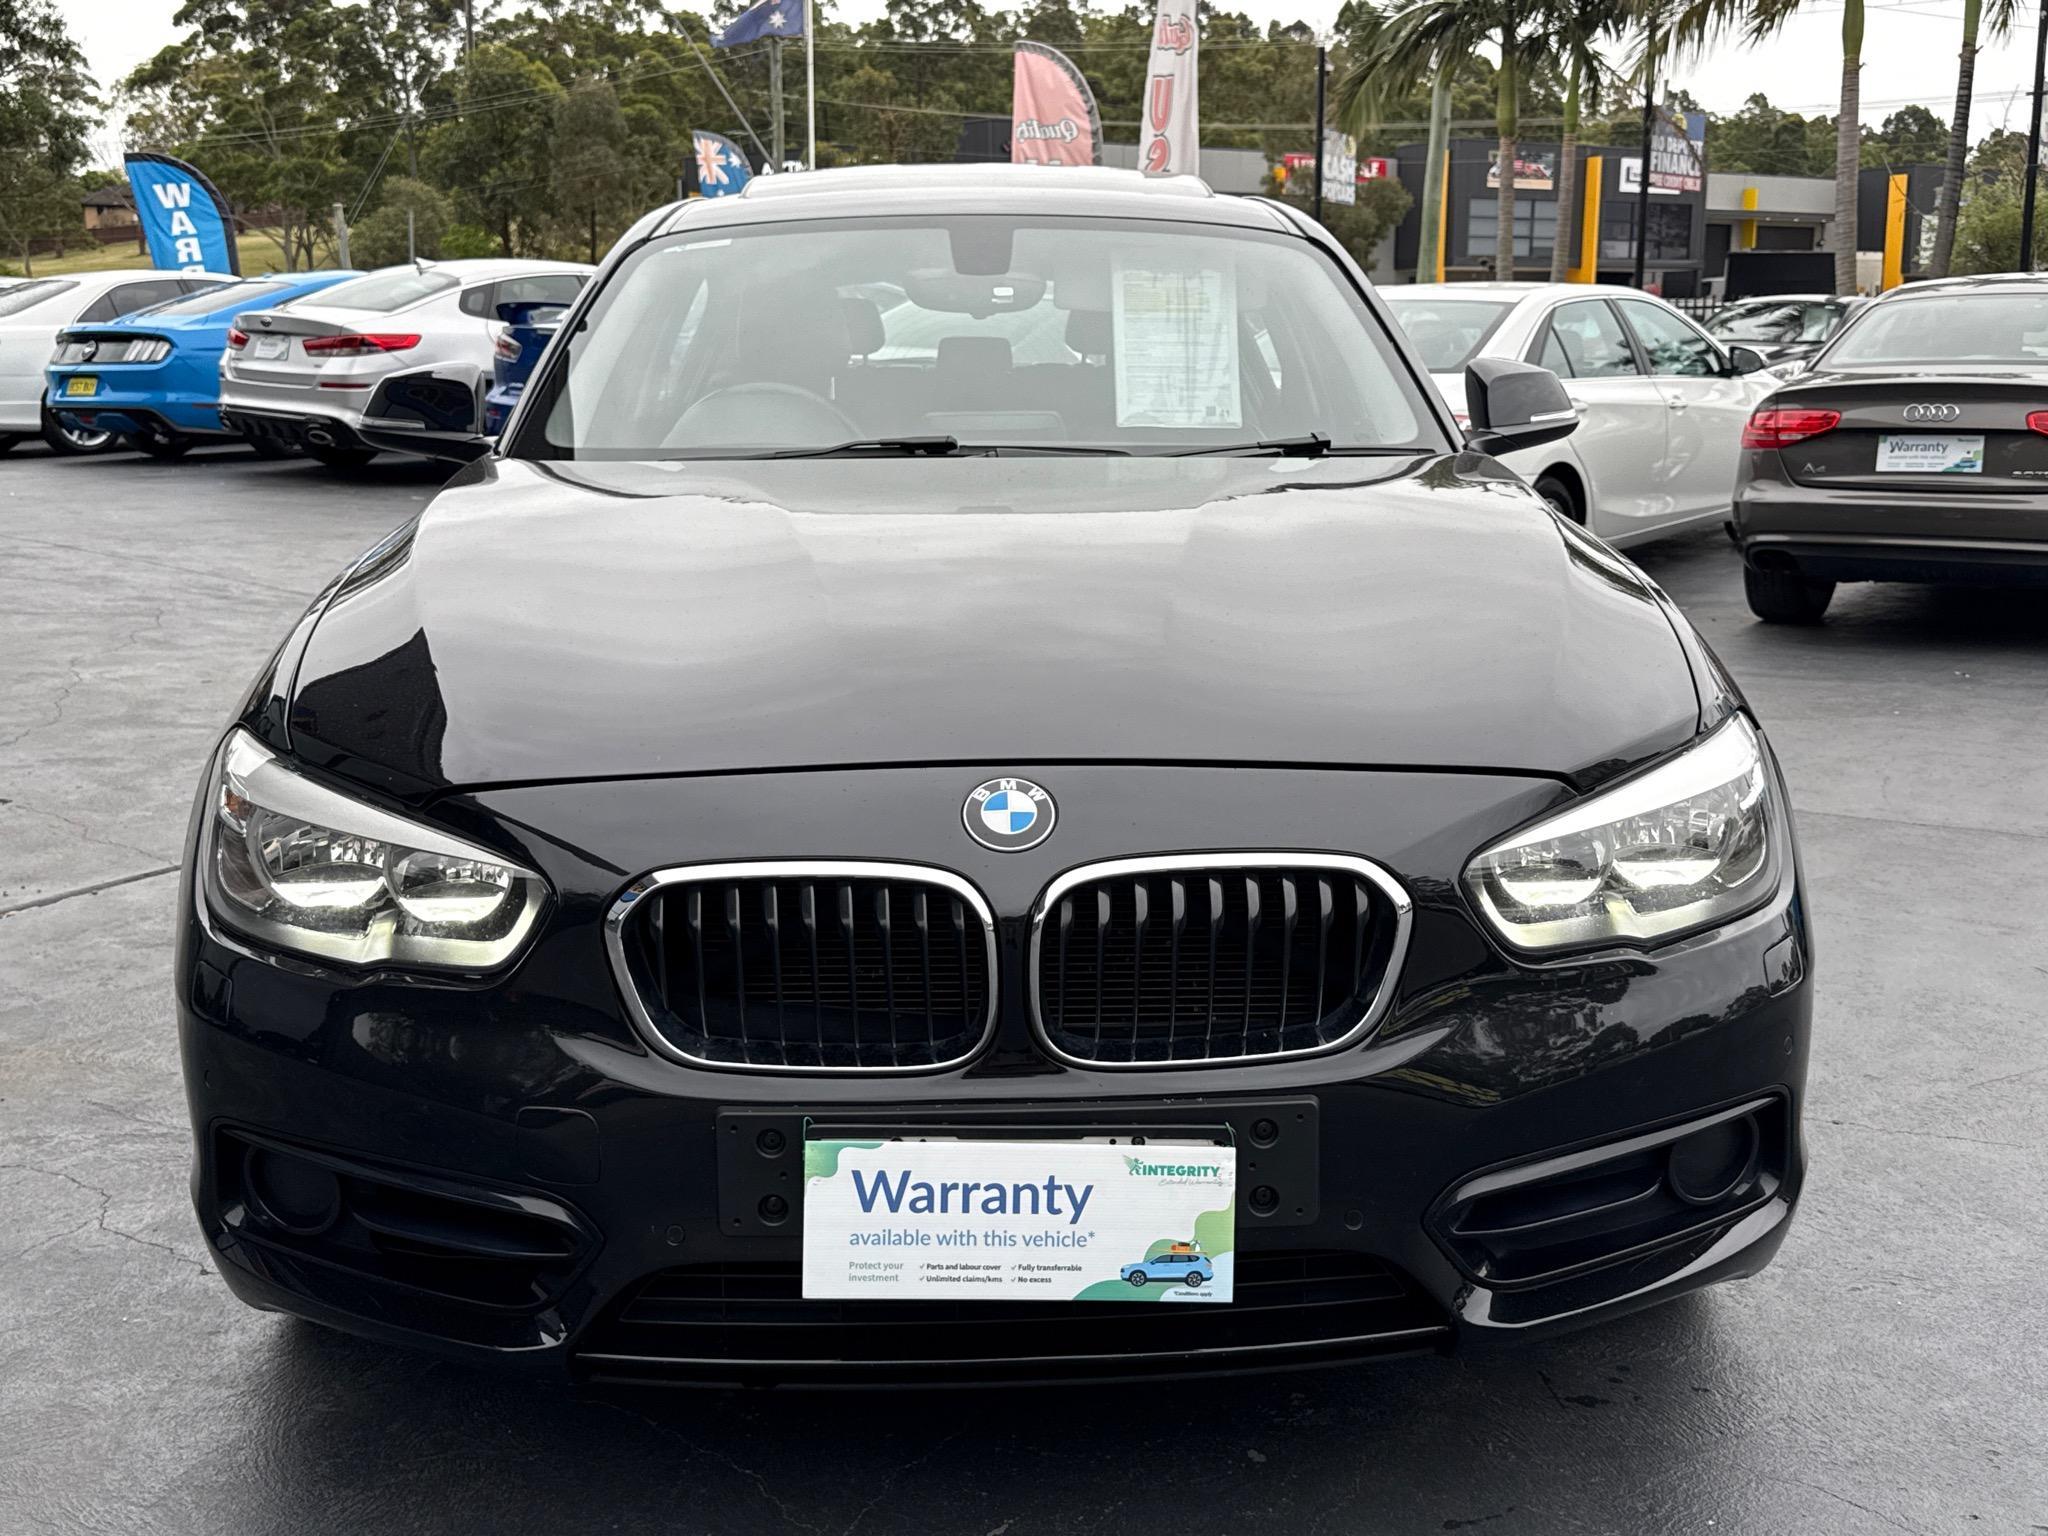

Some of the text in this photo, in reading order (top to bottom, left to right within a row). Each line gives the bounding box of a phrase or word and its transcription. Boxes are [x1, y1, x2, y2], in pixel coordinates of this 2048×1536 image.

[1889, 439, 1949, 454] Warranty
[971, 779, 1046, 802] BMW
[1142, 1164, 1220, 1177] INTEGRITY
[851, 1169, 1095, 1225] Warranty
[849, 1229, 931, 1246] available
[936, 1229, 977, 1247] with
[983, 1230, 1017, 1247] this
[848, 1261, 904, 1272] Protect your
[1017, 1263, 1035, 1272] Fully
[848, 1273, 899, 1282] investment
[926, 1275, 961, 1283] Unlimited
